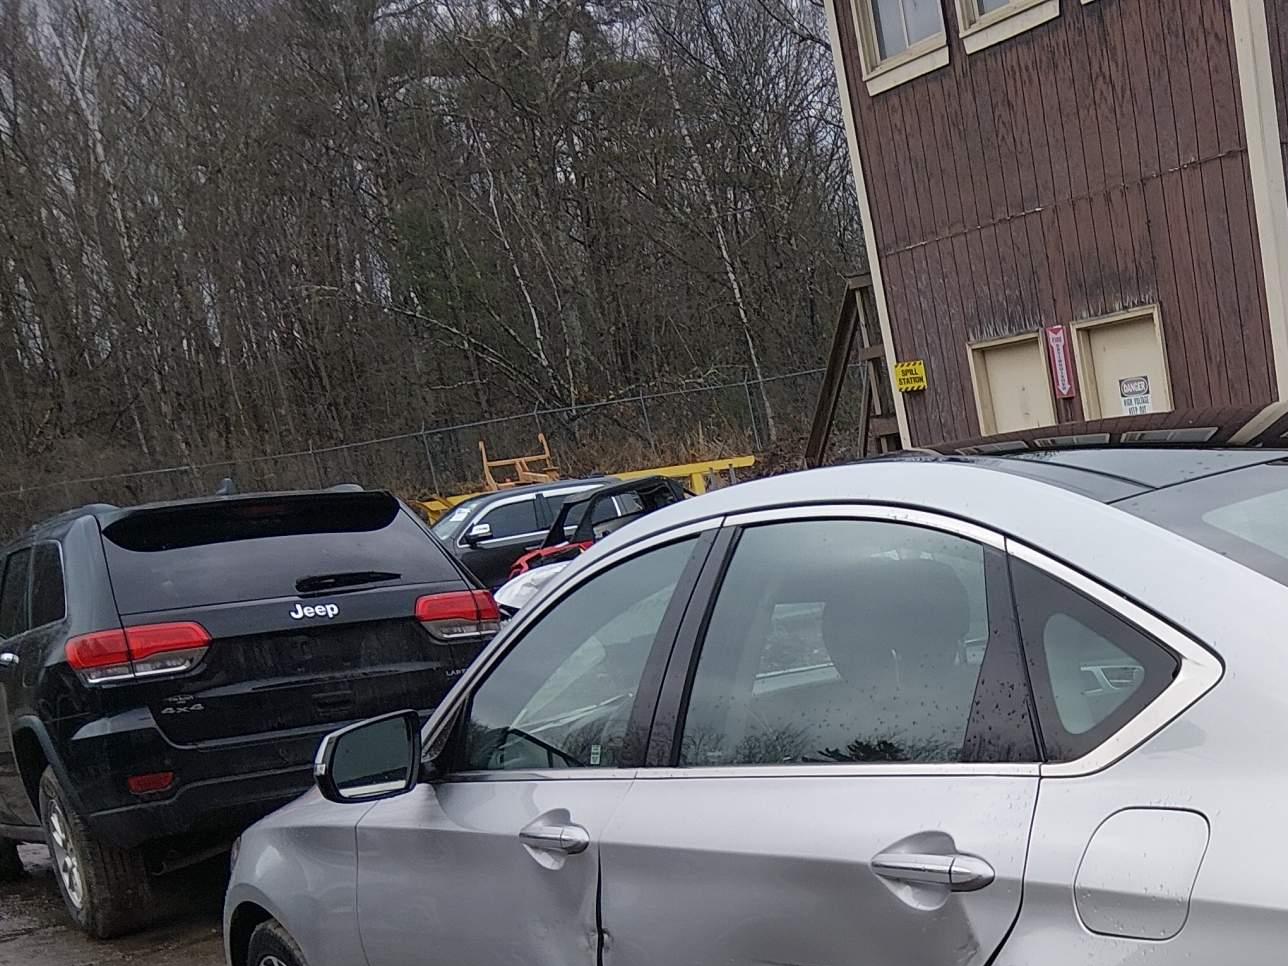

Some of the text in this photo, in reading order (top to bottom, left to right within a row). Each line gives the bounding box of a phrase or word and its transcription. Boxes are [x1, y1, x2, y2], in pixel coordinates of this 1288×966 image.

[901, 368, 919, 377] SPILL
[898, 375, 924, 386] STATION
[290, 603, 339, 619] Jeep
